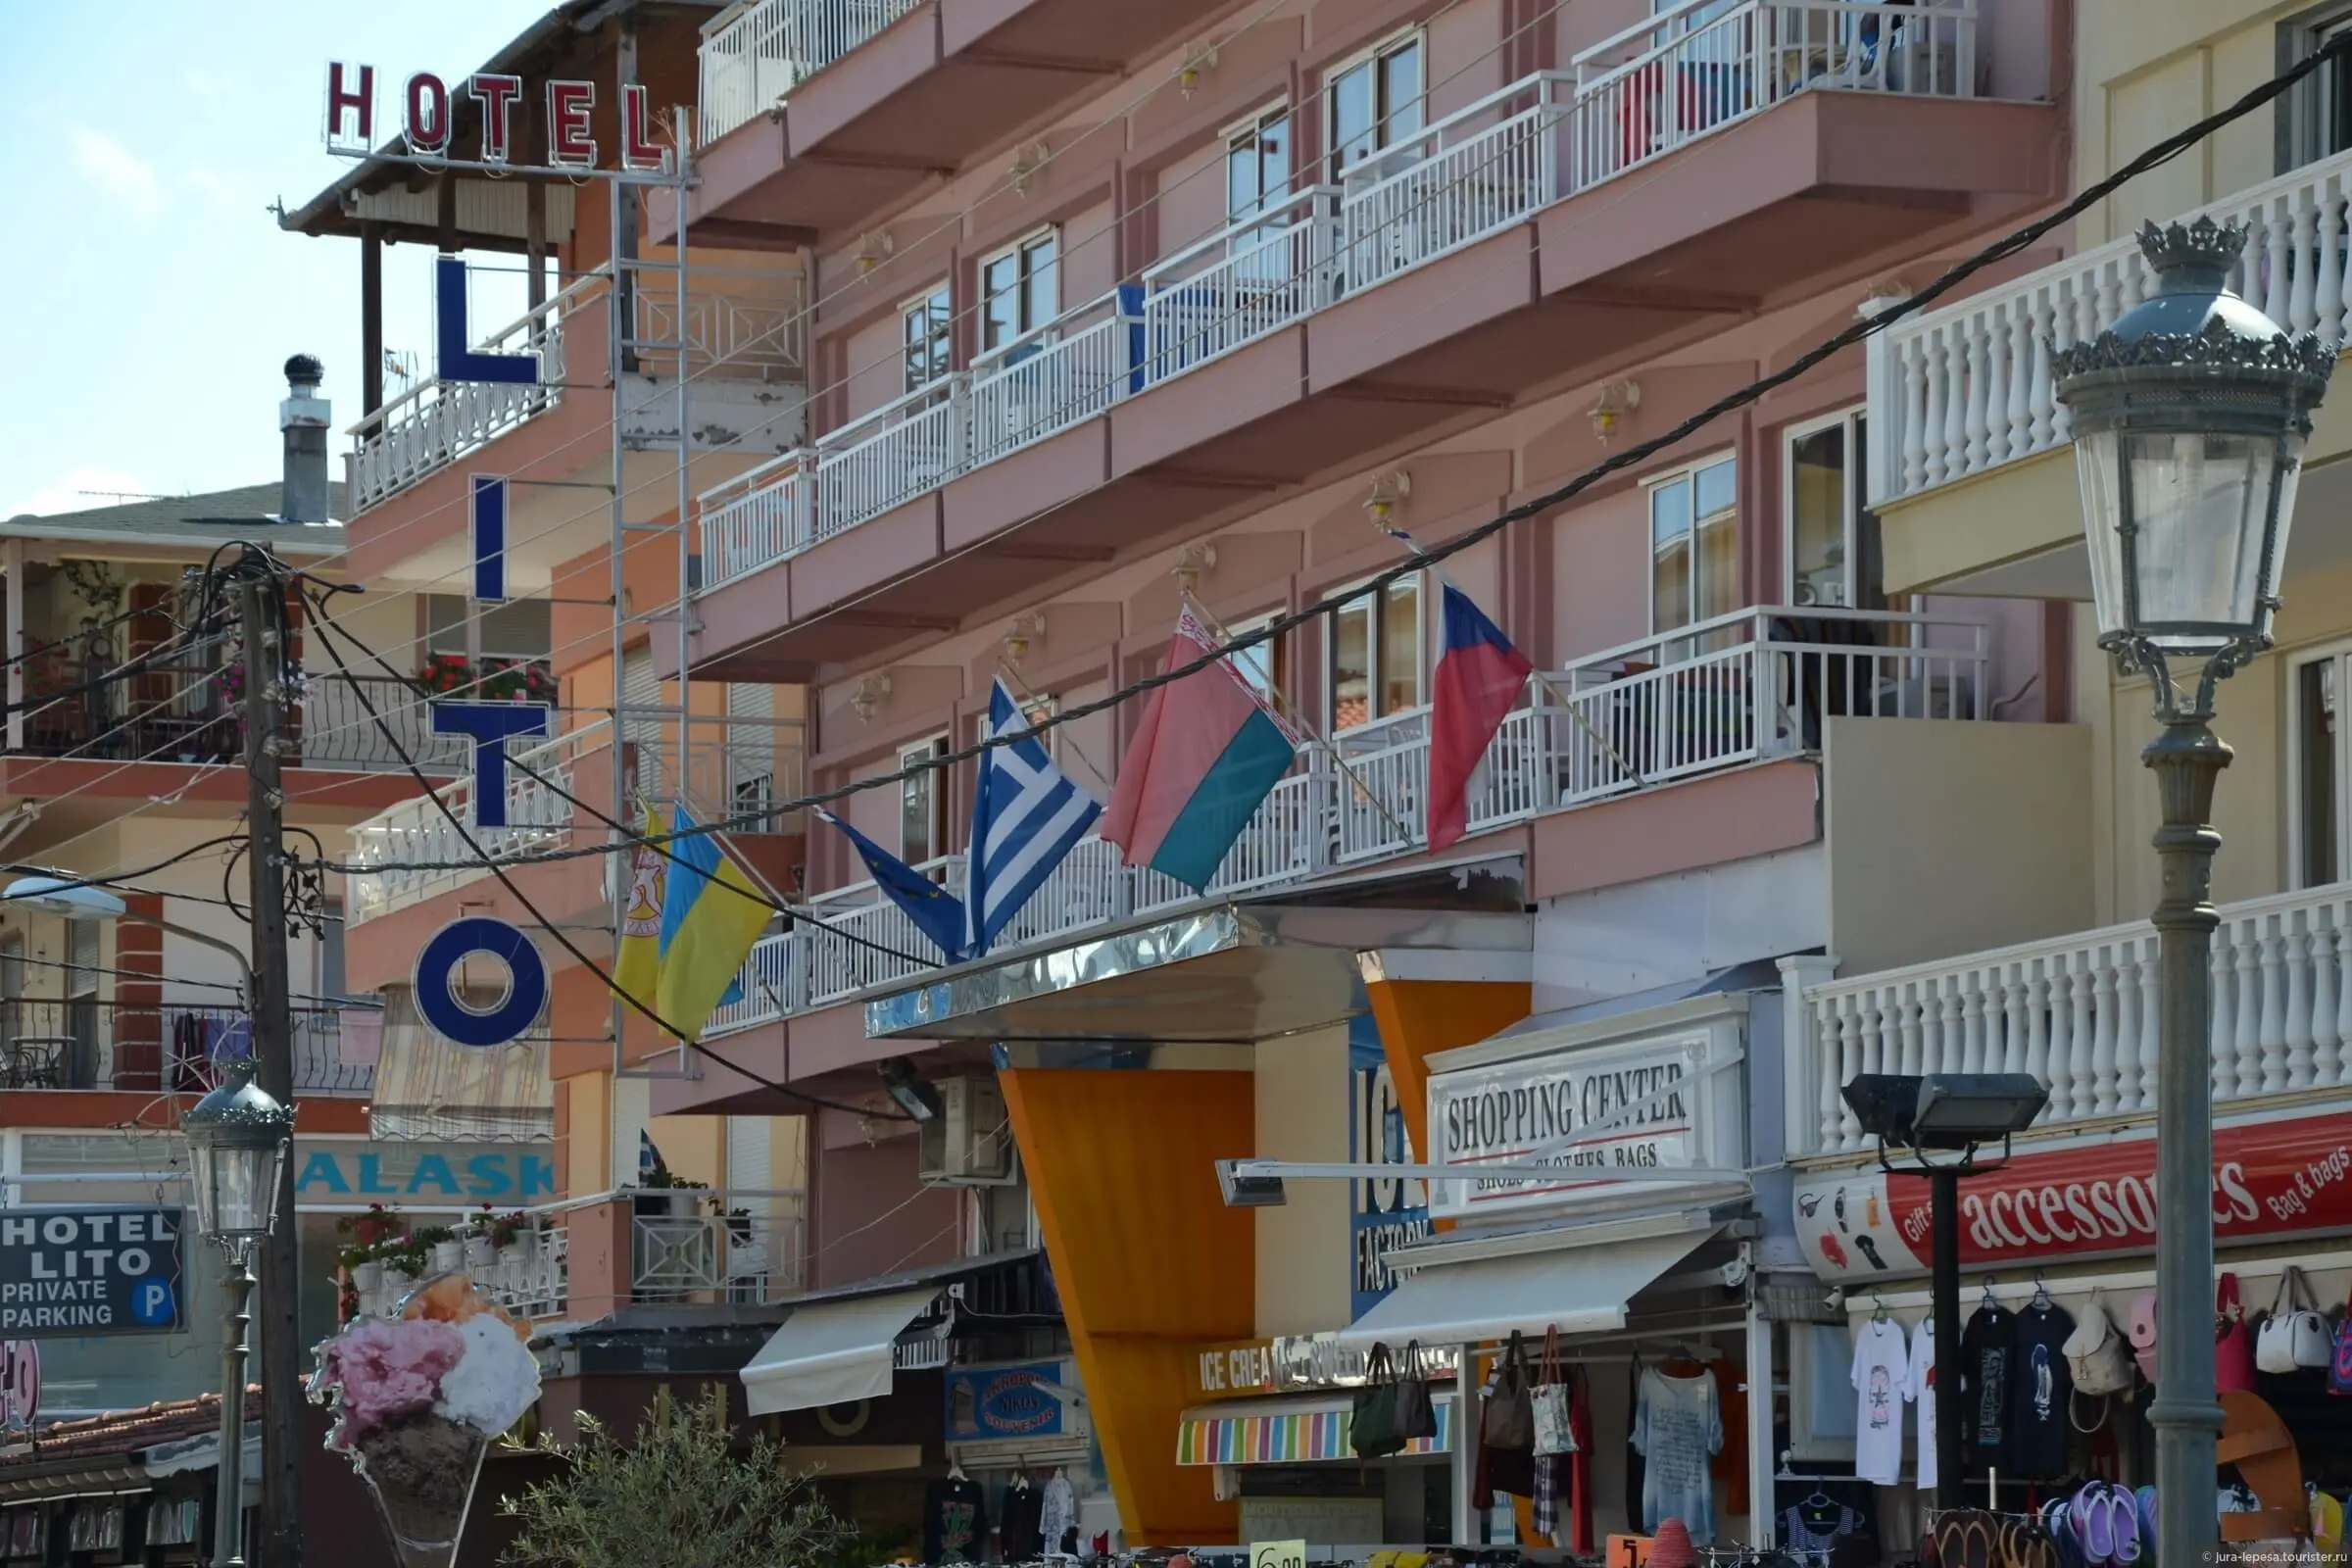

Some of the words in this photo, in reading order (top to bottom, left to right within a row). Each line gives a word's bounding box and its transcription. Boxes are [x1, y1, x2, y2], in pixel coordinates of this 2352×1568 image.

[327, 61, 670, 169] HOTEL
[1448, 1080, 1572, 1153] SHOPPING
[1582, 1063, 1687, 1128] CENTER
[295, 1152, 554, 1195] ALASK
[2266, 1196, 2307, 1221] Bag
[2295, 1172, 2314, 1199] &
[2307, 1146, 2350, 1189] bags
[1963, 1161, 2260, 1250] accessos
[2, 1214, 174, 1246] HOTEL
[31, 1248, 151, 1279] LITO
[2, 1279, 108, 1303] PRIVATE
[145, 1285, 165, 1317] P
[2, 1304, 113, 1329] PARKING
[1200, 1351, 1226, 1392] ICE
[1309, 1340, 1376, 1380] SWEET
[983, 1371, 1052, 1403] AKROPO
[1000, 1393, 1041, 1414] NIKOS
[983, 1407, 1054, 1434] SOUVENIR
